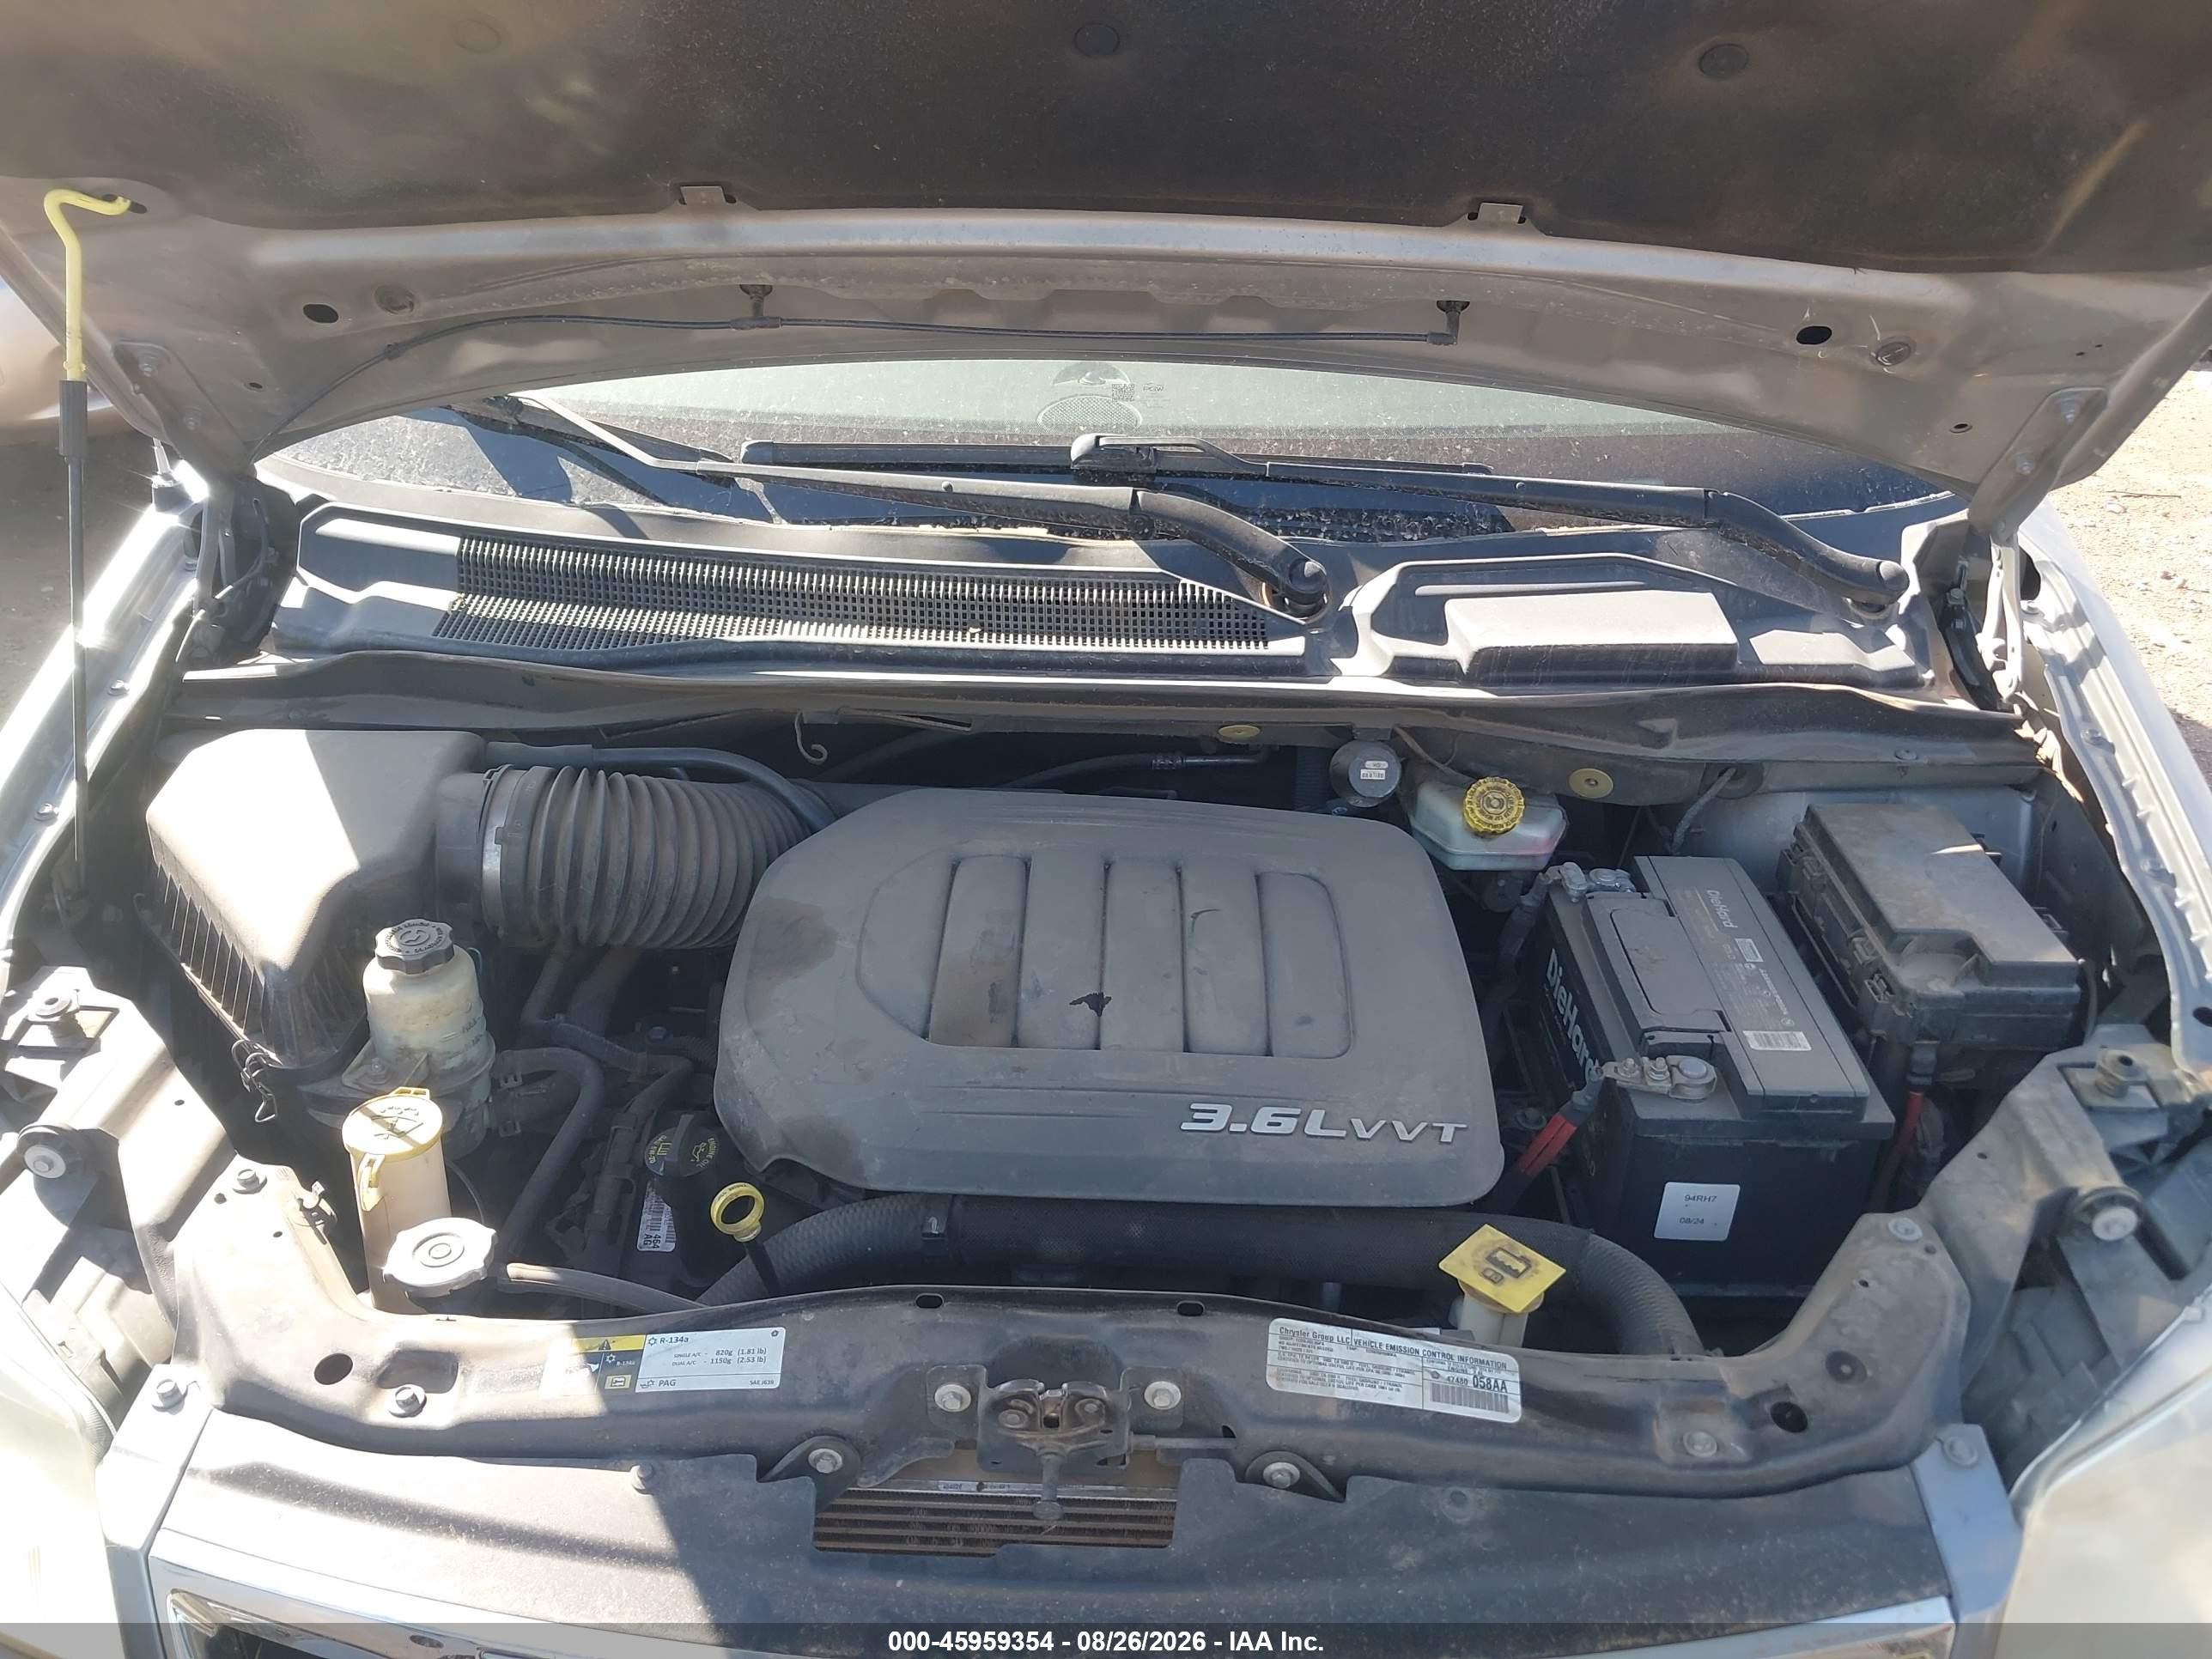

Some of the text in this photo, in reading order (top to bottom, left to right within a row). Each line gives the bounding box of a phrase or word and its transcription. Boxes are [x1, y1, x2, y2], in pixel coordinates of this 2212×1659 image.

[1707, 890, 1738, 928] DieHard
[644, 1233, 652, 1246] AG
[652, 1234, 660, 1249] 464
[659, 1336, 689, 1345] R-134a
[715, 1349, 732, 1358] 820g
[737, 1347, 756, 1356] (1.81
[757, 1346, 767, 1355] lb)
[1279, 1327, 1310, 1338] Chrysler
[1312, 1331, 1334, 1342] Group
[1336, 1334, 1351, 1345] LLC
[1353, 1338, 1383, 1349] VEHICLE
[1385, 1343, 1420, 1355] EMISSION
[1422, 1349, 1455, 1361] CONTROL
[1457, 1355, 1507, 1369] INFORMATION
[737, 1356, 756, 1364] (2.53
[757, 1355, 767, 1364] lb)
[658, 1379, 677, 1388] PAG
[1473, 1375, 1508, 1393] 058AA
